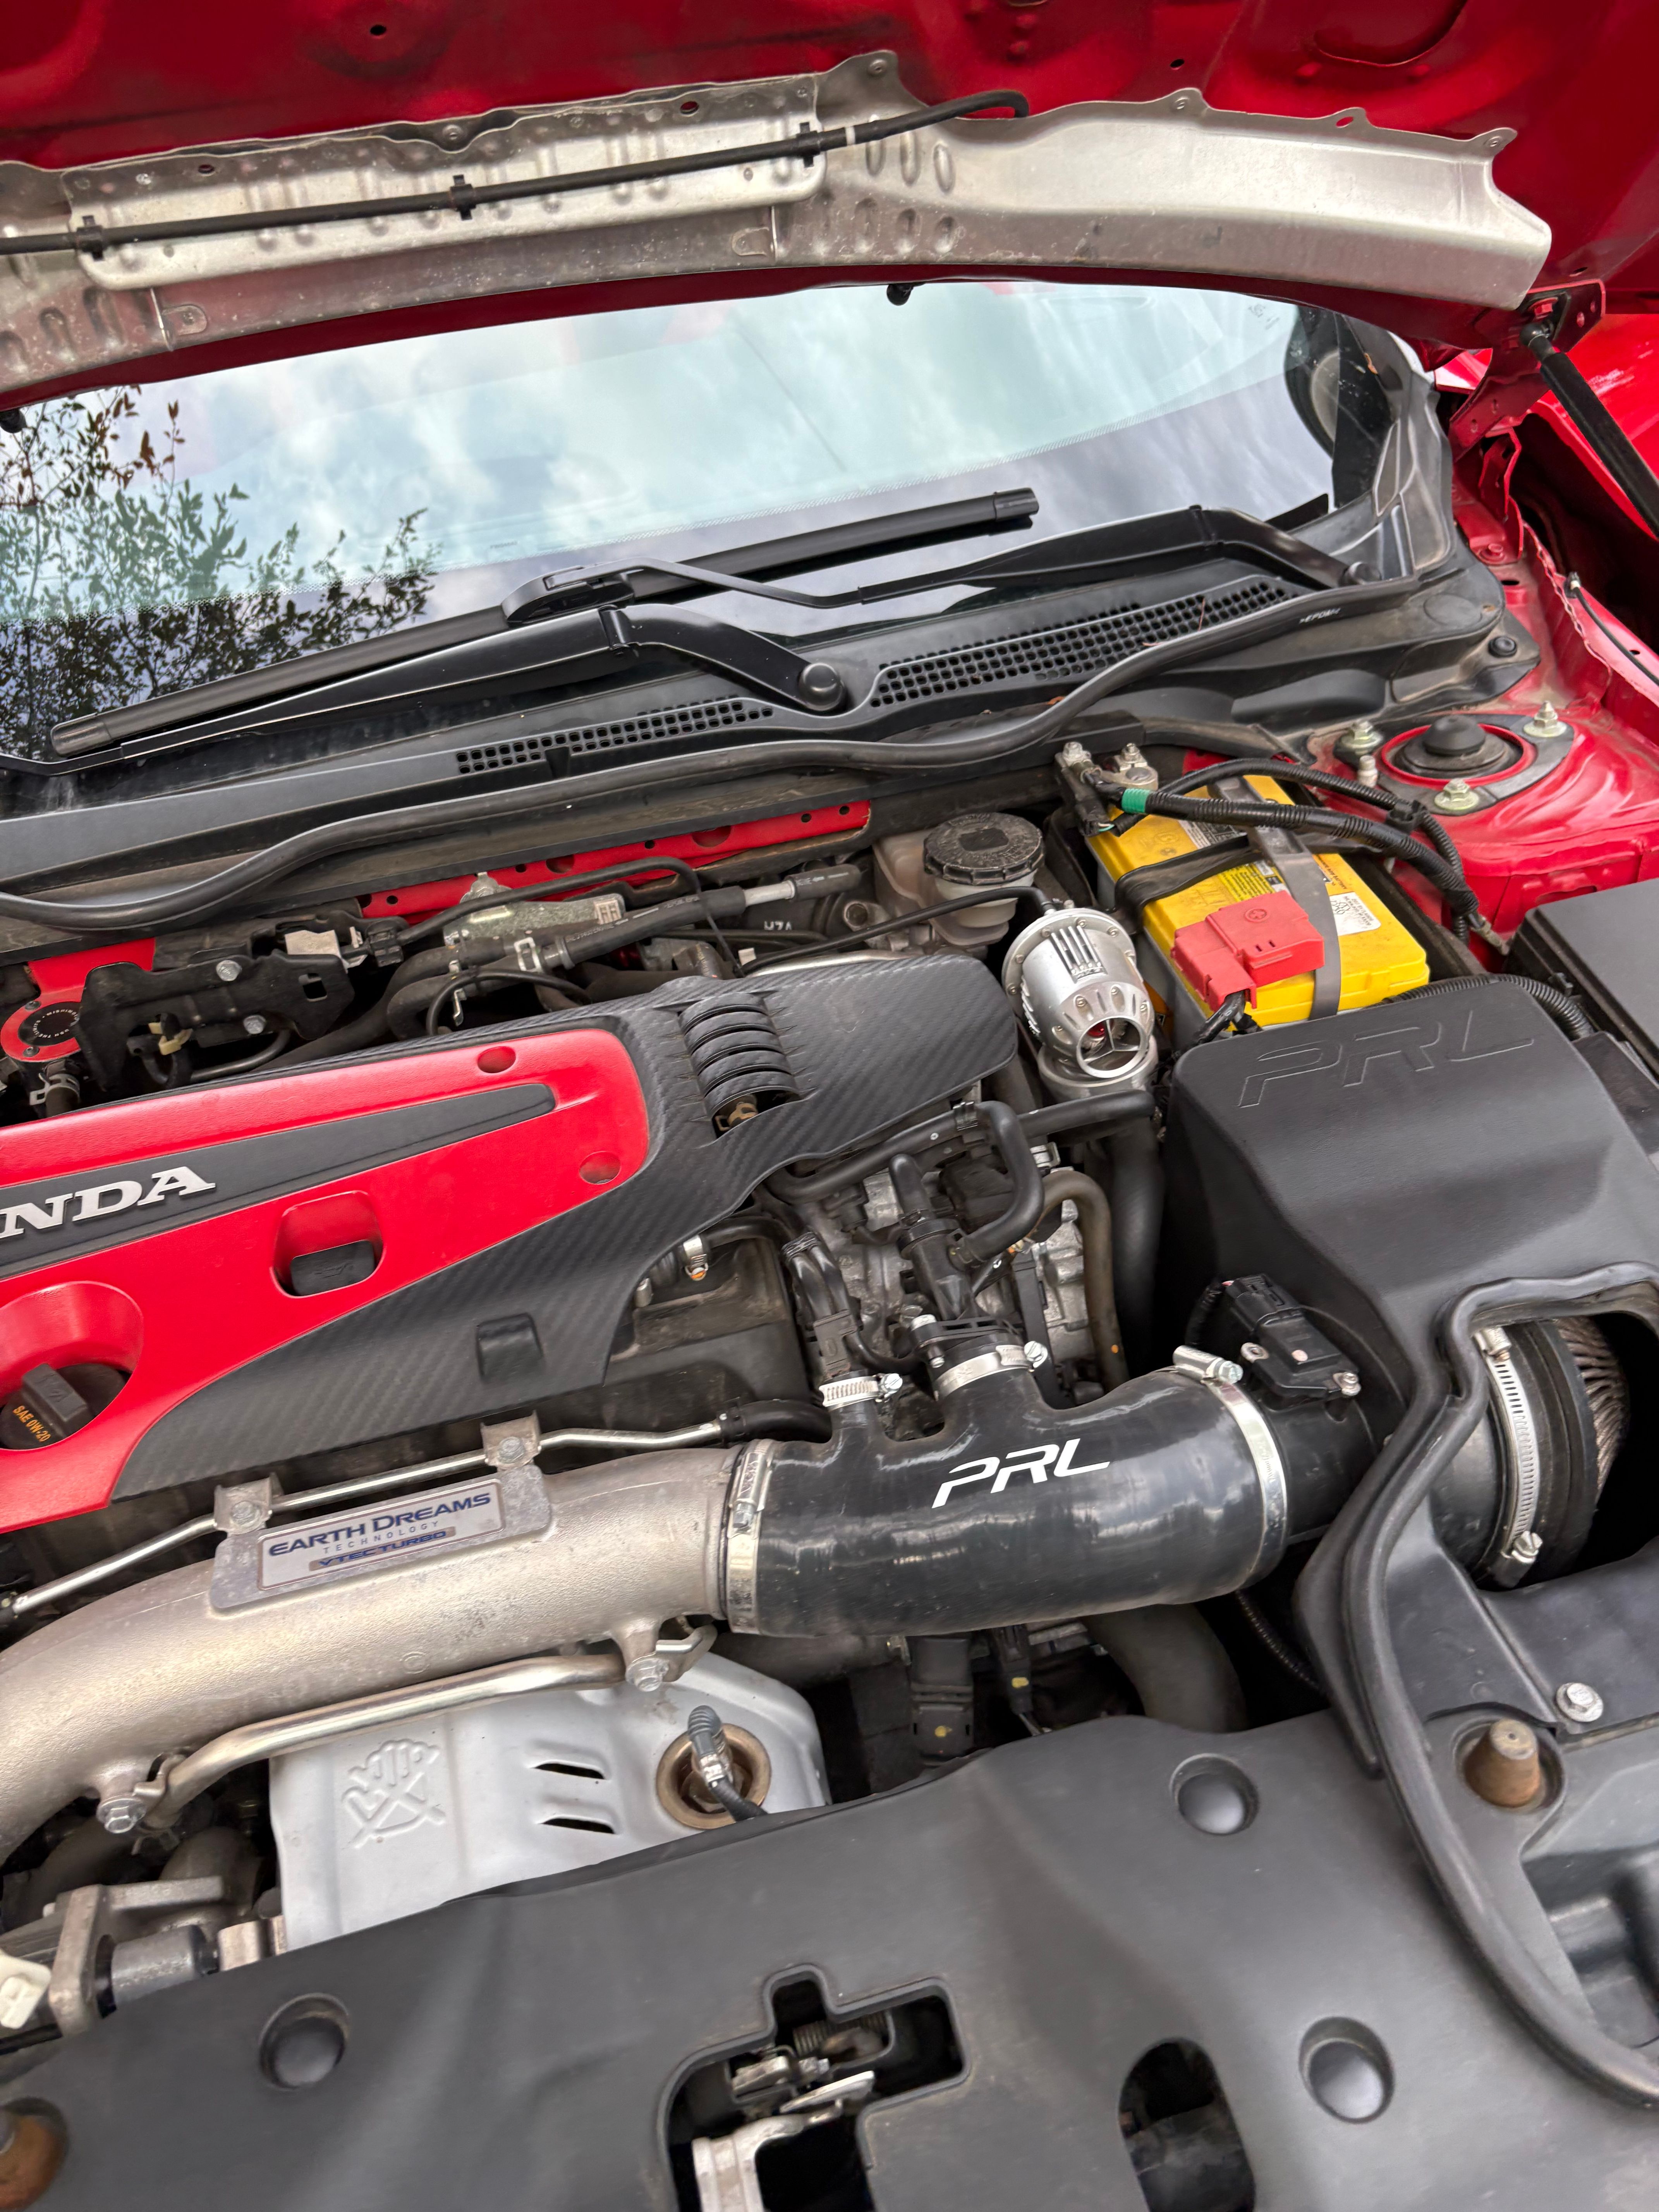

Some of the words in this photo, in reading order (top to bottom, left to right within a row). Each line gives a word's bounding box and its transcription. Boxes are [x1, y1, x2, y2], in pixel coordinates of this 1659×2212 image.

[1237, 1009, 1534, 1108] PRL
[12, 1405, 34, 1423] SAE
[25, 1419, 51, 1442] 0W-20
[931, 1438, 1111, 1509] PRL
[268, 1523, 365, 1556] EARTH
[372, 1492, 491, 1532] DREAMS
[318, 1549, 376, 1566] VTEC
[380, 1530, 447, 1553] TURBO
[323, 1520, 439, 1554] TECHNOLOGY
